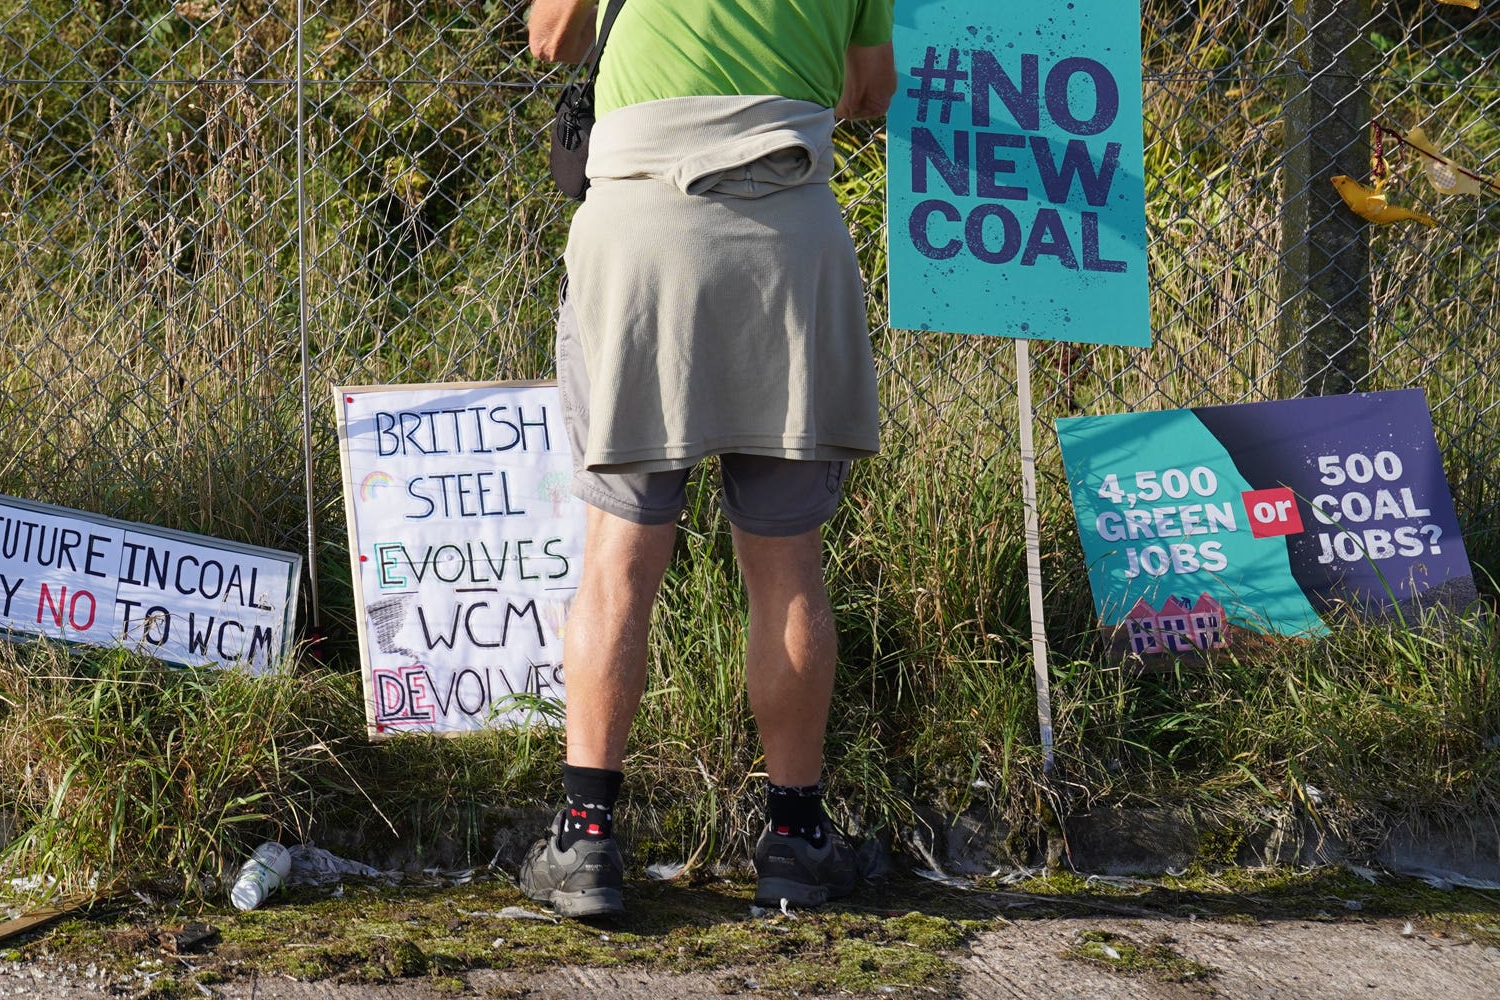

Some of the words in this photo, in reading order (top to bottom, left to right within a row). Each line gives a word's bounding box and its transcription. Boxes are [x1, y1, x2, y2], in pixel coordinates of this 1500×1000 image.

[906, 46, 1120, 136] #NO
[910, 126, 1122, 206] NEW
[908, 199, 1127, 273] COAL
[376, 406, 551, 457] BRITISH
[1097, 465, 1219, 510] 4,500
[1317, 450, 1403, 486] 500
[405, 471, 526, 519] STEEL
[1253, 497, 1292, 525] or
[1311, 487, 1431, 526] COAL
[1096, 501, 1238, 542] GREEN
[1317, 523, 1443, 564] JOBS?
[119, 541, 170, 590] IN
[174, 554, 273, 611] COAL
[375, 539, 569, 588] EVOLVES
[1123, 541, 1229, 578] JOBS
[36, 582, 97, 631] NO
[116, 598, 171, 645] TO
[188, 612, 273, 668] WCM
[417, 599, 547, 650] WCM
